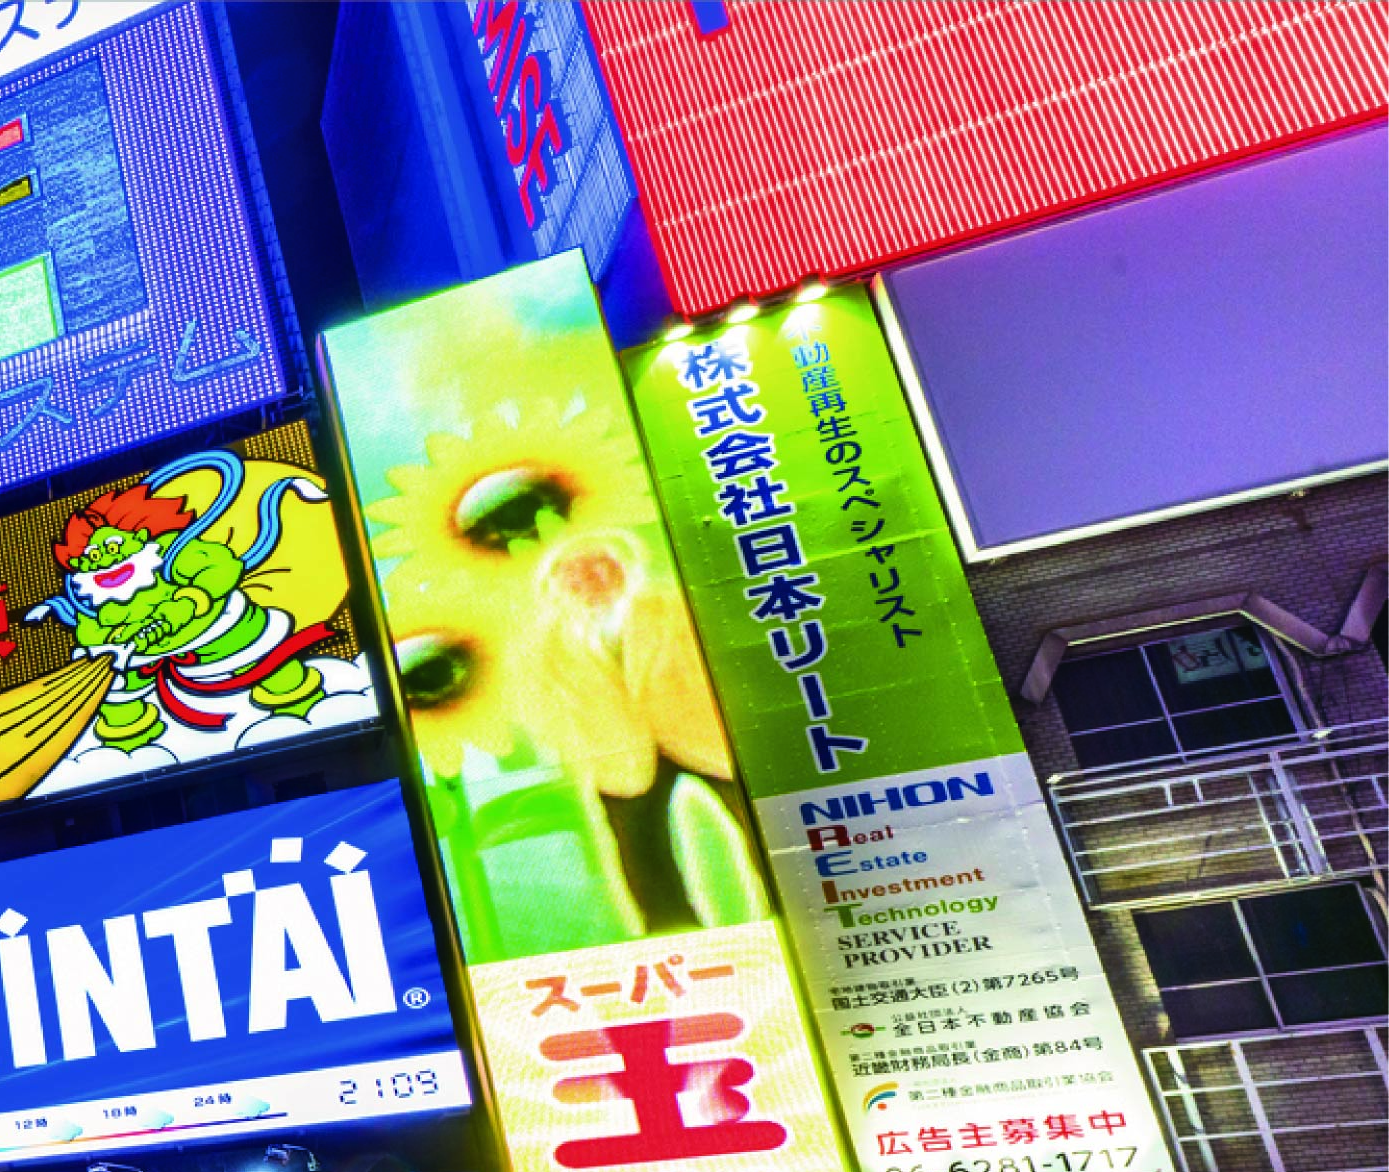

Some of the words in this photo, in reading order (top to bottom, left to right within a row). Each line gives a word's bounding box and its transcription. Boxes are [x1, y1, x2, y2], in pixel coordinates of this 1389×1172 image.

[790, 320, 923, 649] 不動産再生のスペシャリスト
[682, 338, 866, 771] 株式会社日本リート
[799, 772, 994, 826] NIHON
[807, 825, 894, 853] Real
[814, 849, 928, 877] Estate
[822, 868, 986, 905] Investment
[824, 895, 999, 930] Technology
[837, 921, 962, 952] SERVICE
[844, 936, 994, 970] PROVIDER
[525, 954, 735, 1017] スーパー
[893, 1001, 1091, 1038] 全日本不動産協会
[337, 1069, 440, 1107] 2109
[877, 1110, 1128, 1157] 広告主募集中
